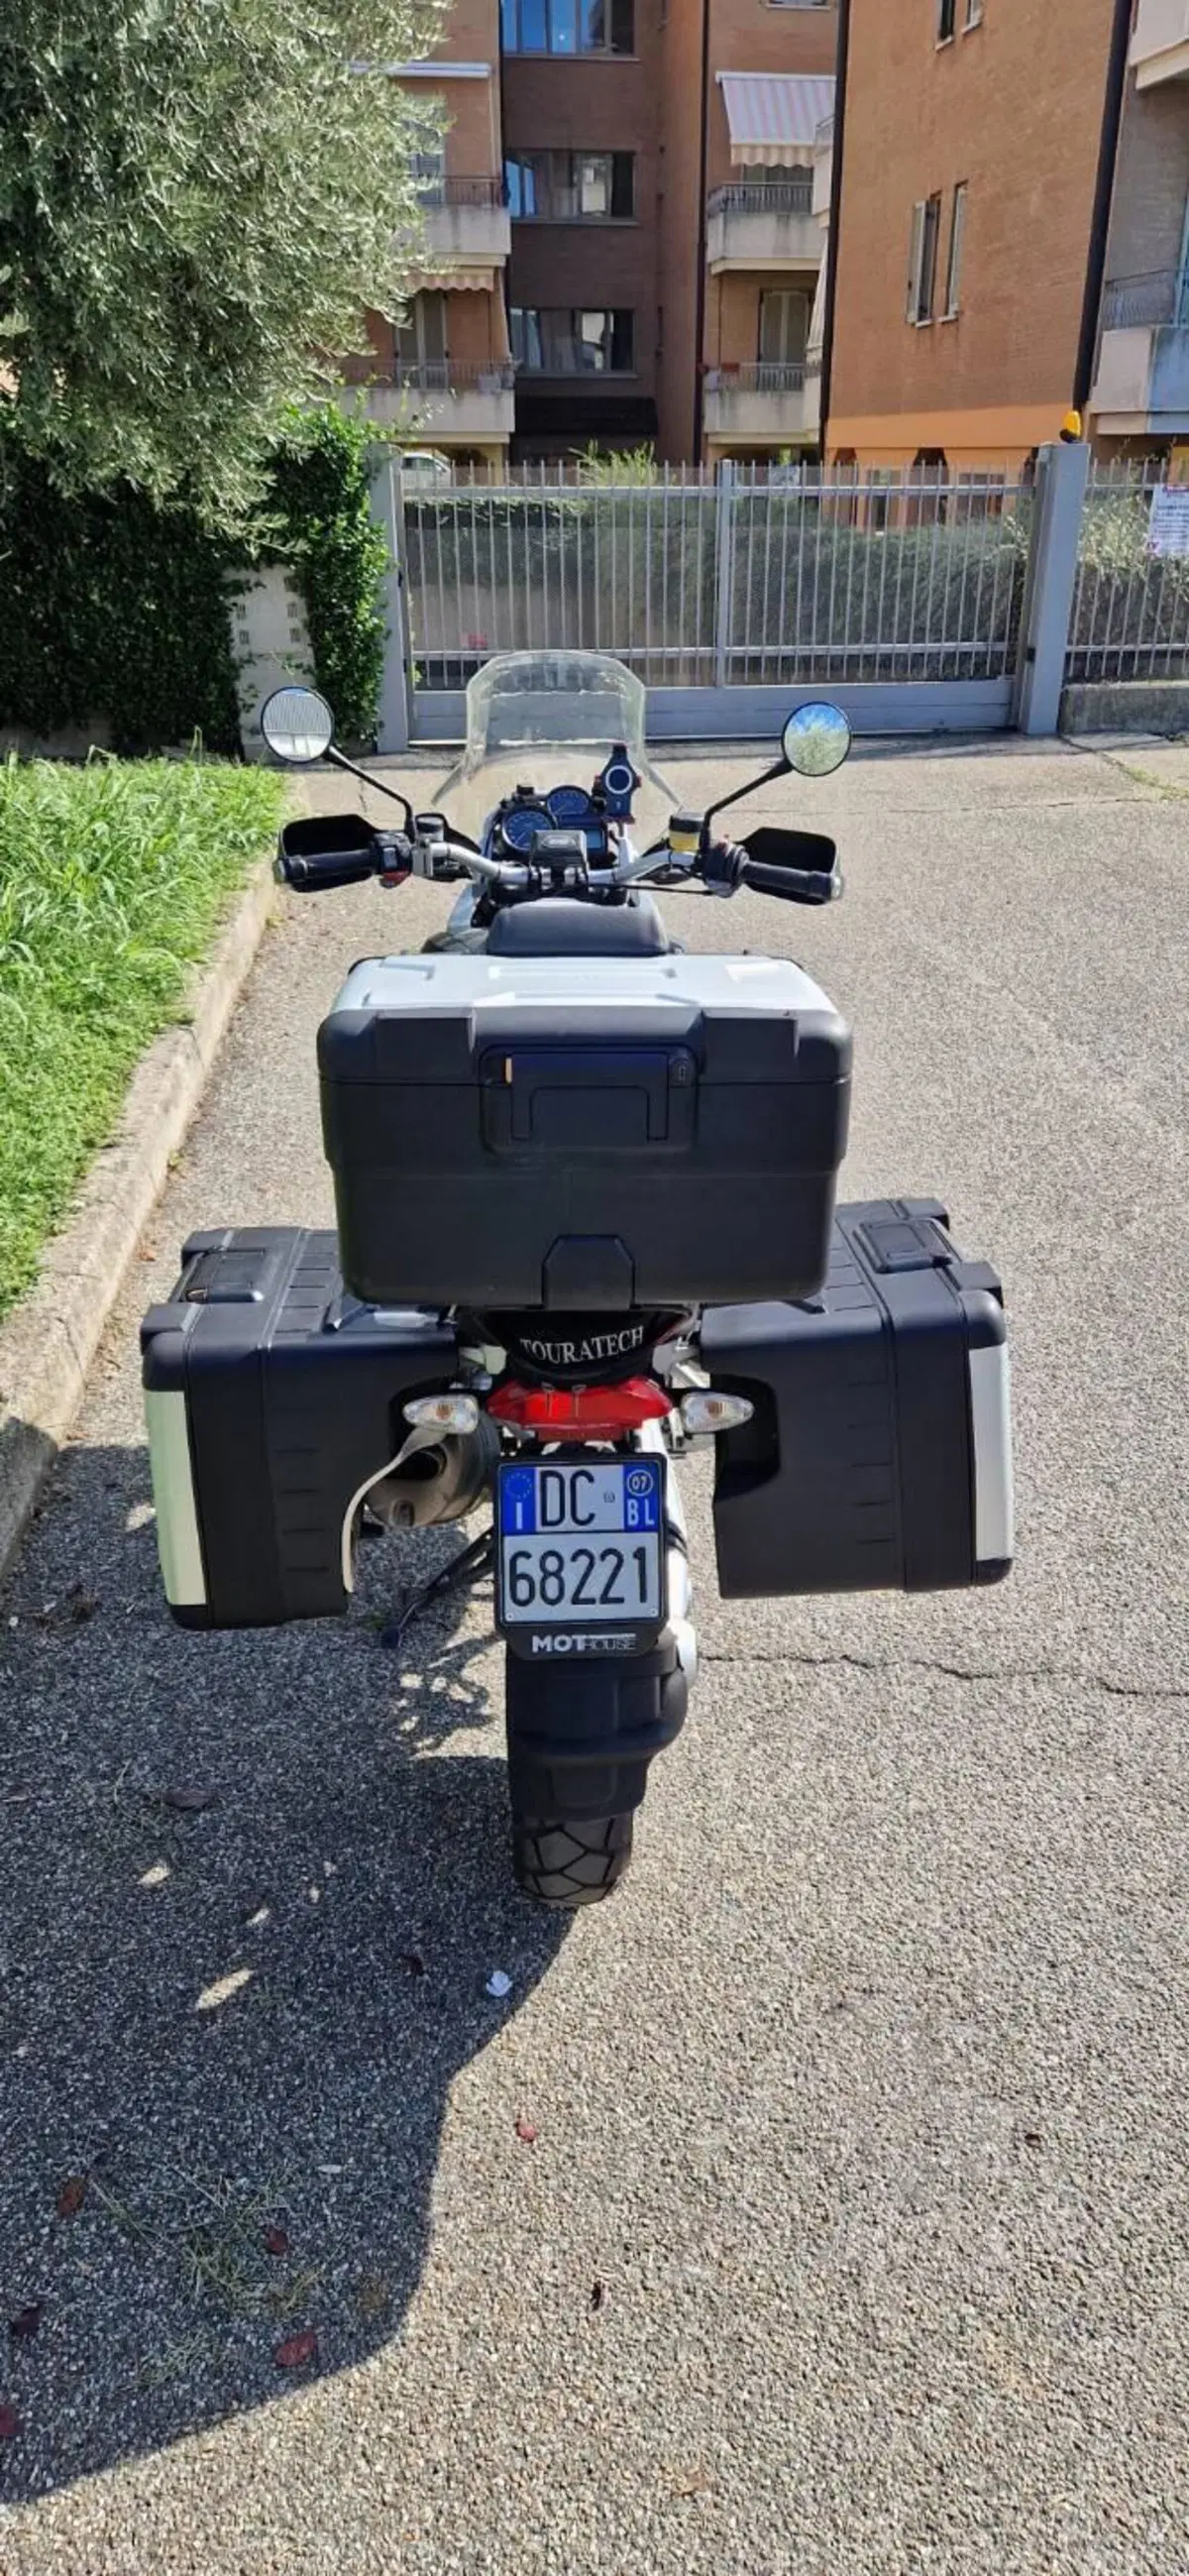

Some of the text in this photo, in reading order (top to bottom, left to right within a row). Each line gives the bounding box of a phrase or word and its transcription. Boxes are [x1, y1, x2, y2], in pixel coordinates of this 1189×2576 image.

[520, 1325, 643, 1364] TOURATECH
[539, 1470, 595, 1526] DC
[631, 1475, 647, 1490] 07
[627, 1499, 655, 1525] BL
[509, 1546, 647, 1607] 68221
